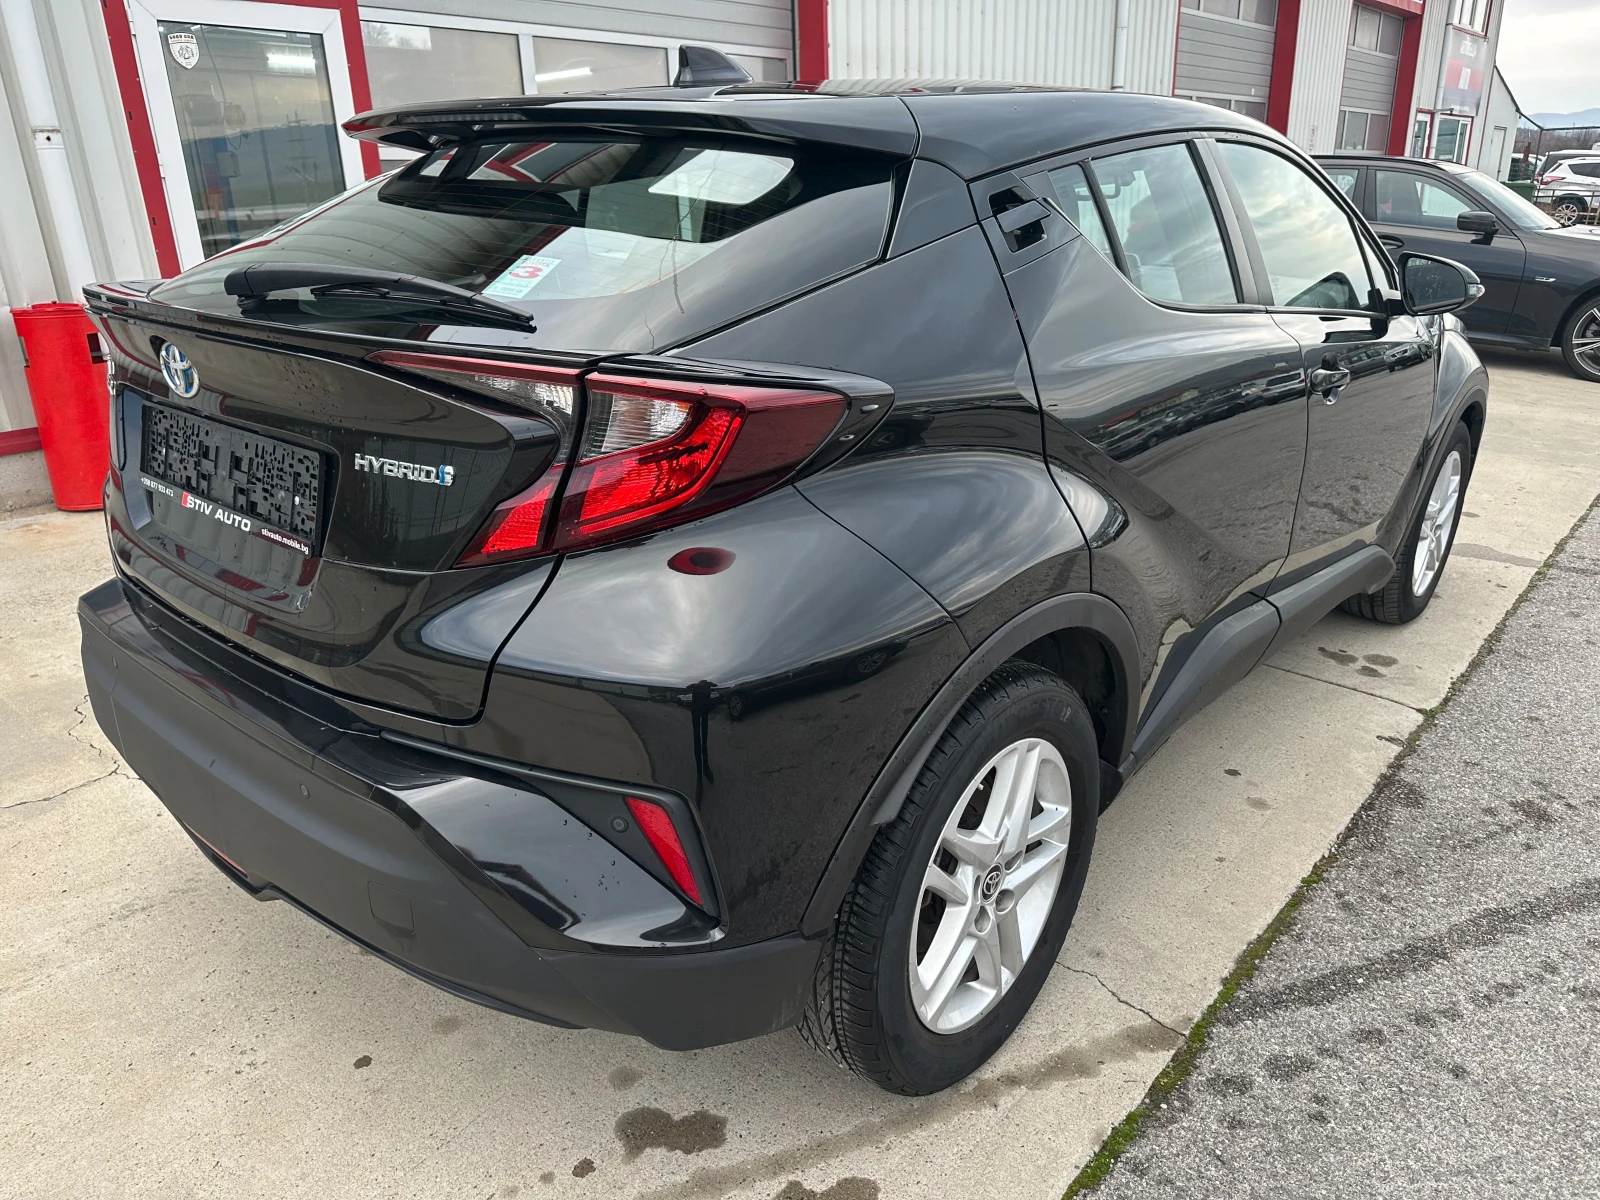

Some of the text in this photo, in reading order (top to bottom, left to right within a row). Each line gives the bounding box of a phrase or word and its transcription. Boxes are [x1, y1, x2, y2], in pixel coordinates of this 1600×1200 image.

[509, 265, 543, 279] 3
[355, 453, 436, 484] HYBRID
[186, 495, 252, 532] STIV AUTO
[261, 529, 309, 555] stivauto.mobile.bg
